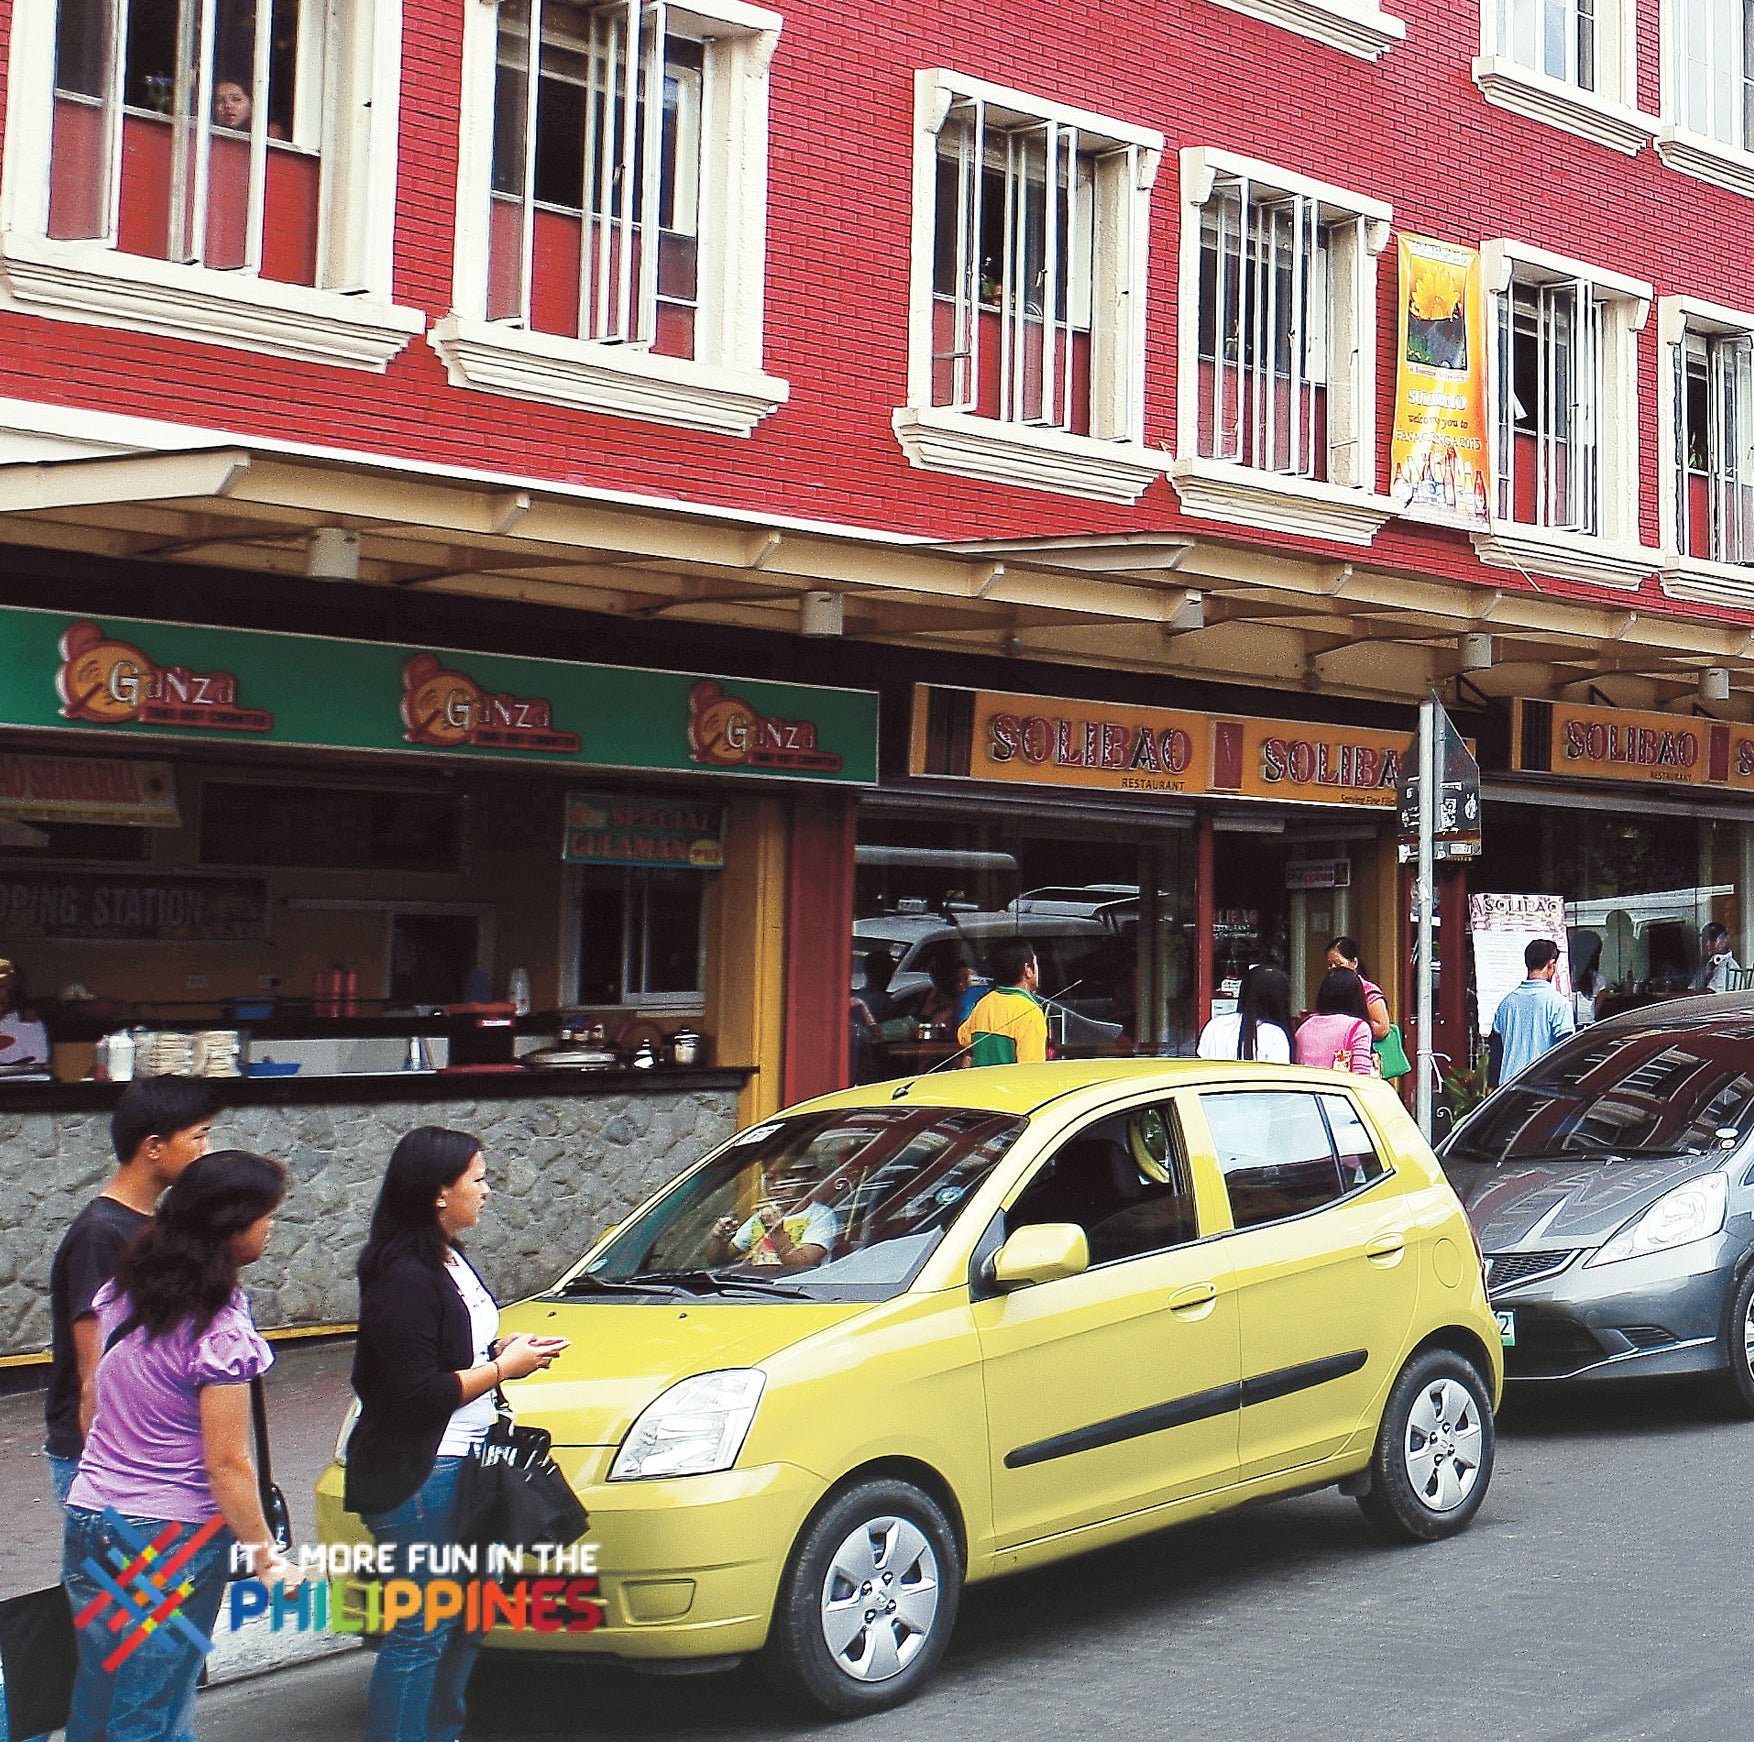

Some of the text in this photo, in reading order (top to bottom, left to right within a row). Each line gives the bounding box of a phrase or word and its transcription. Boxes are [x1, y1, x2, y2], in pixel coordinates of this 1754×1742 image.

[989, 714, 1193, 774] SOLIBAO
[1262, 738, 1402, 790] SOLIBA
[1566, 719, 1699, 768] SOLIBAO
[1121, 777, 1185, 791] RESTAURANT
[570, 831, 686, 861] GULAMAN
